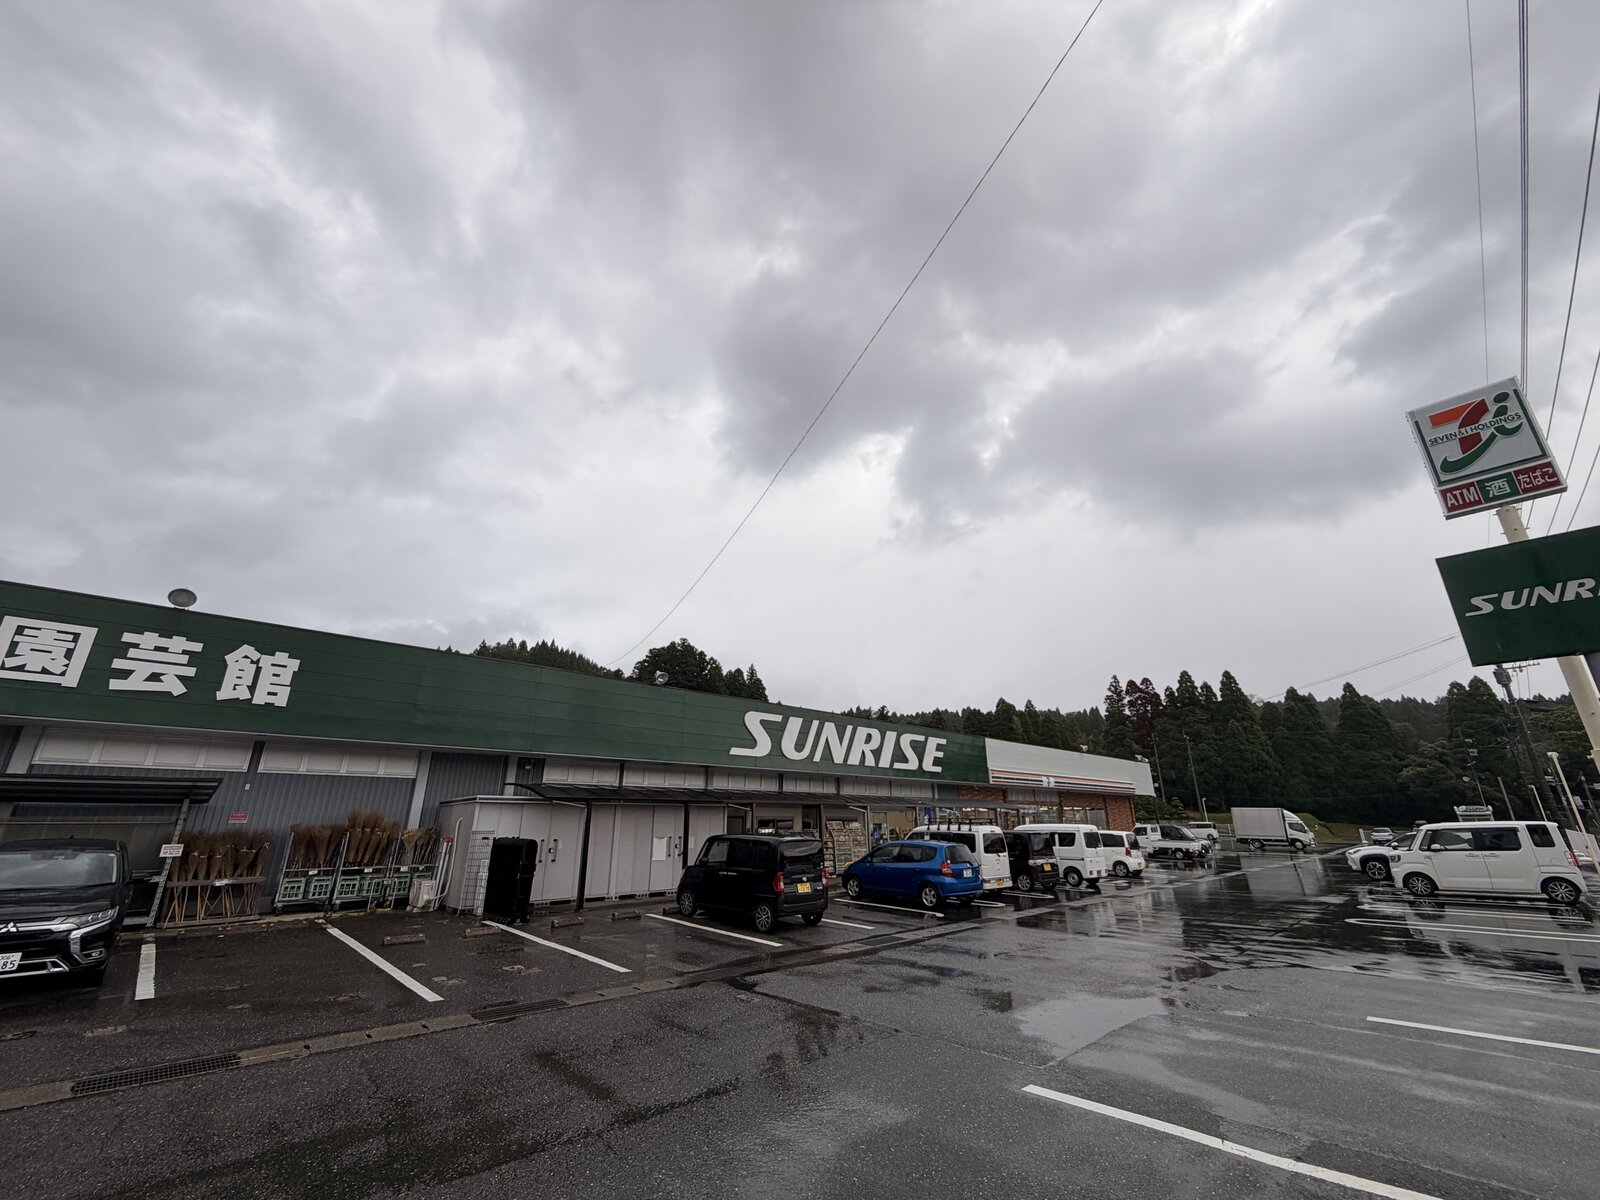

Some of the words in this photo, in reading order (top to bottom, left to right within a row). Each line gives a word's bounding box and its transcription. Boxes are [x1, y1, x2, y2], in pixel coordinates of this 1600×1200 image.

[1470, 412, 1522, 433] HOLDINGS
[1484, 478, 1511, 498] 酒
[1517, 467, 1558, 489] たばこ
[1447, 486, 1479, 508] ATM
[1465, 577, 1600, 617] SUNR
[0, 615, 301, 707] 園芸館
[728, 710, 947, 773] SUNRISE
